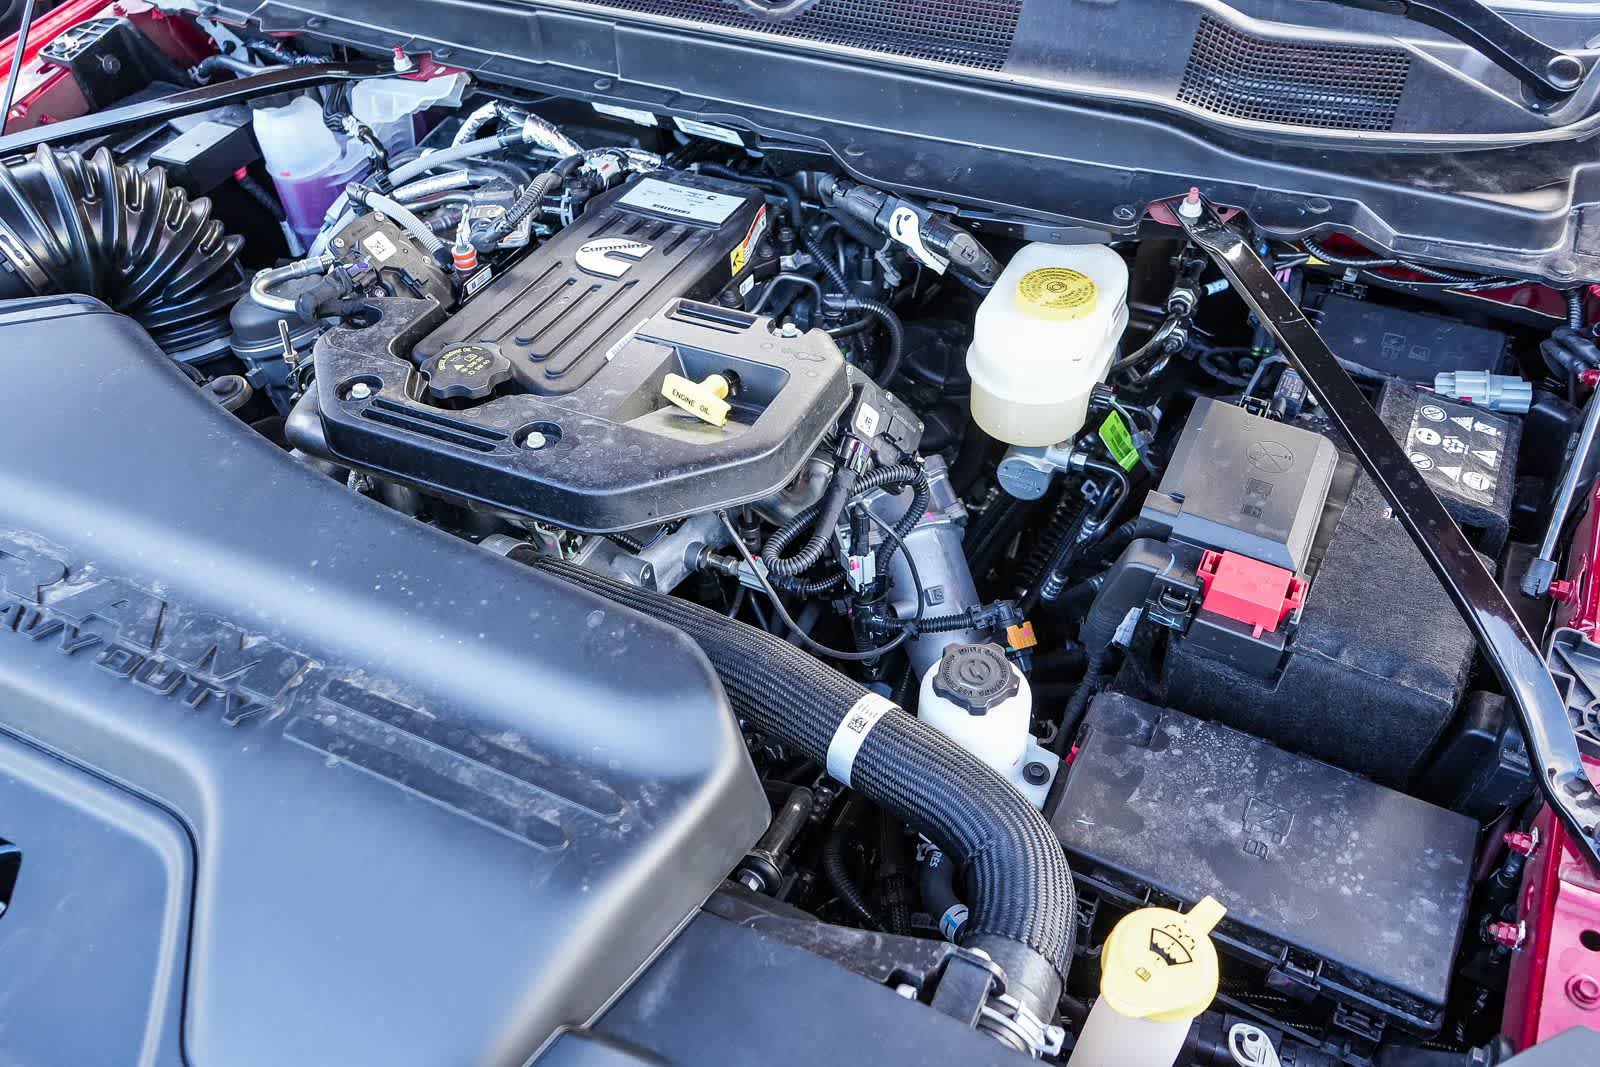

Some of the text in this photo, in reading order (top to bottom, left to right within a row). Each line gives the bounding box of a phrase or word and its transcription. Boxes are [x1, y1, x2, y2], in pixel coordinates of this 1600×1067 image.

[581, 243, 649, 253] Cummins
[672, 388, 710, 415] ENGINE OIL
[95, 642, 266, 727] DUTY
